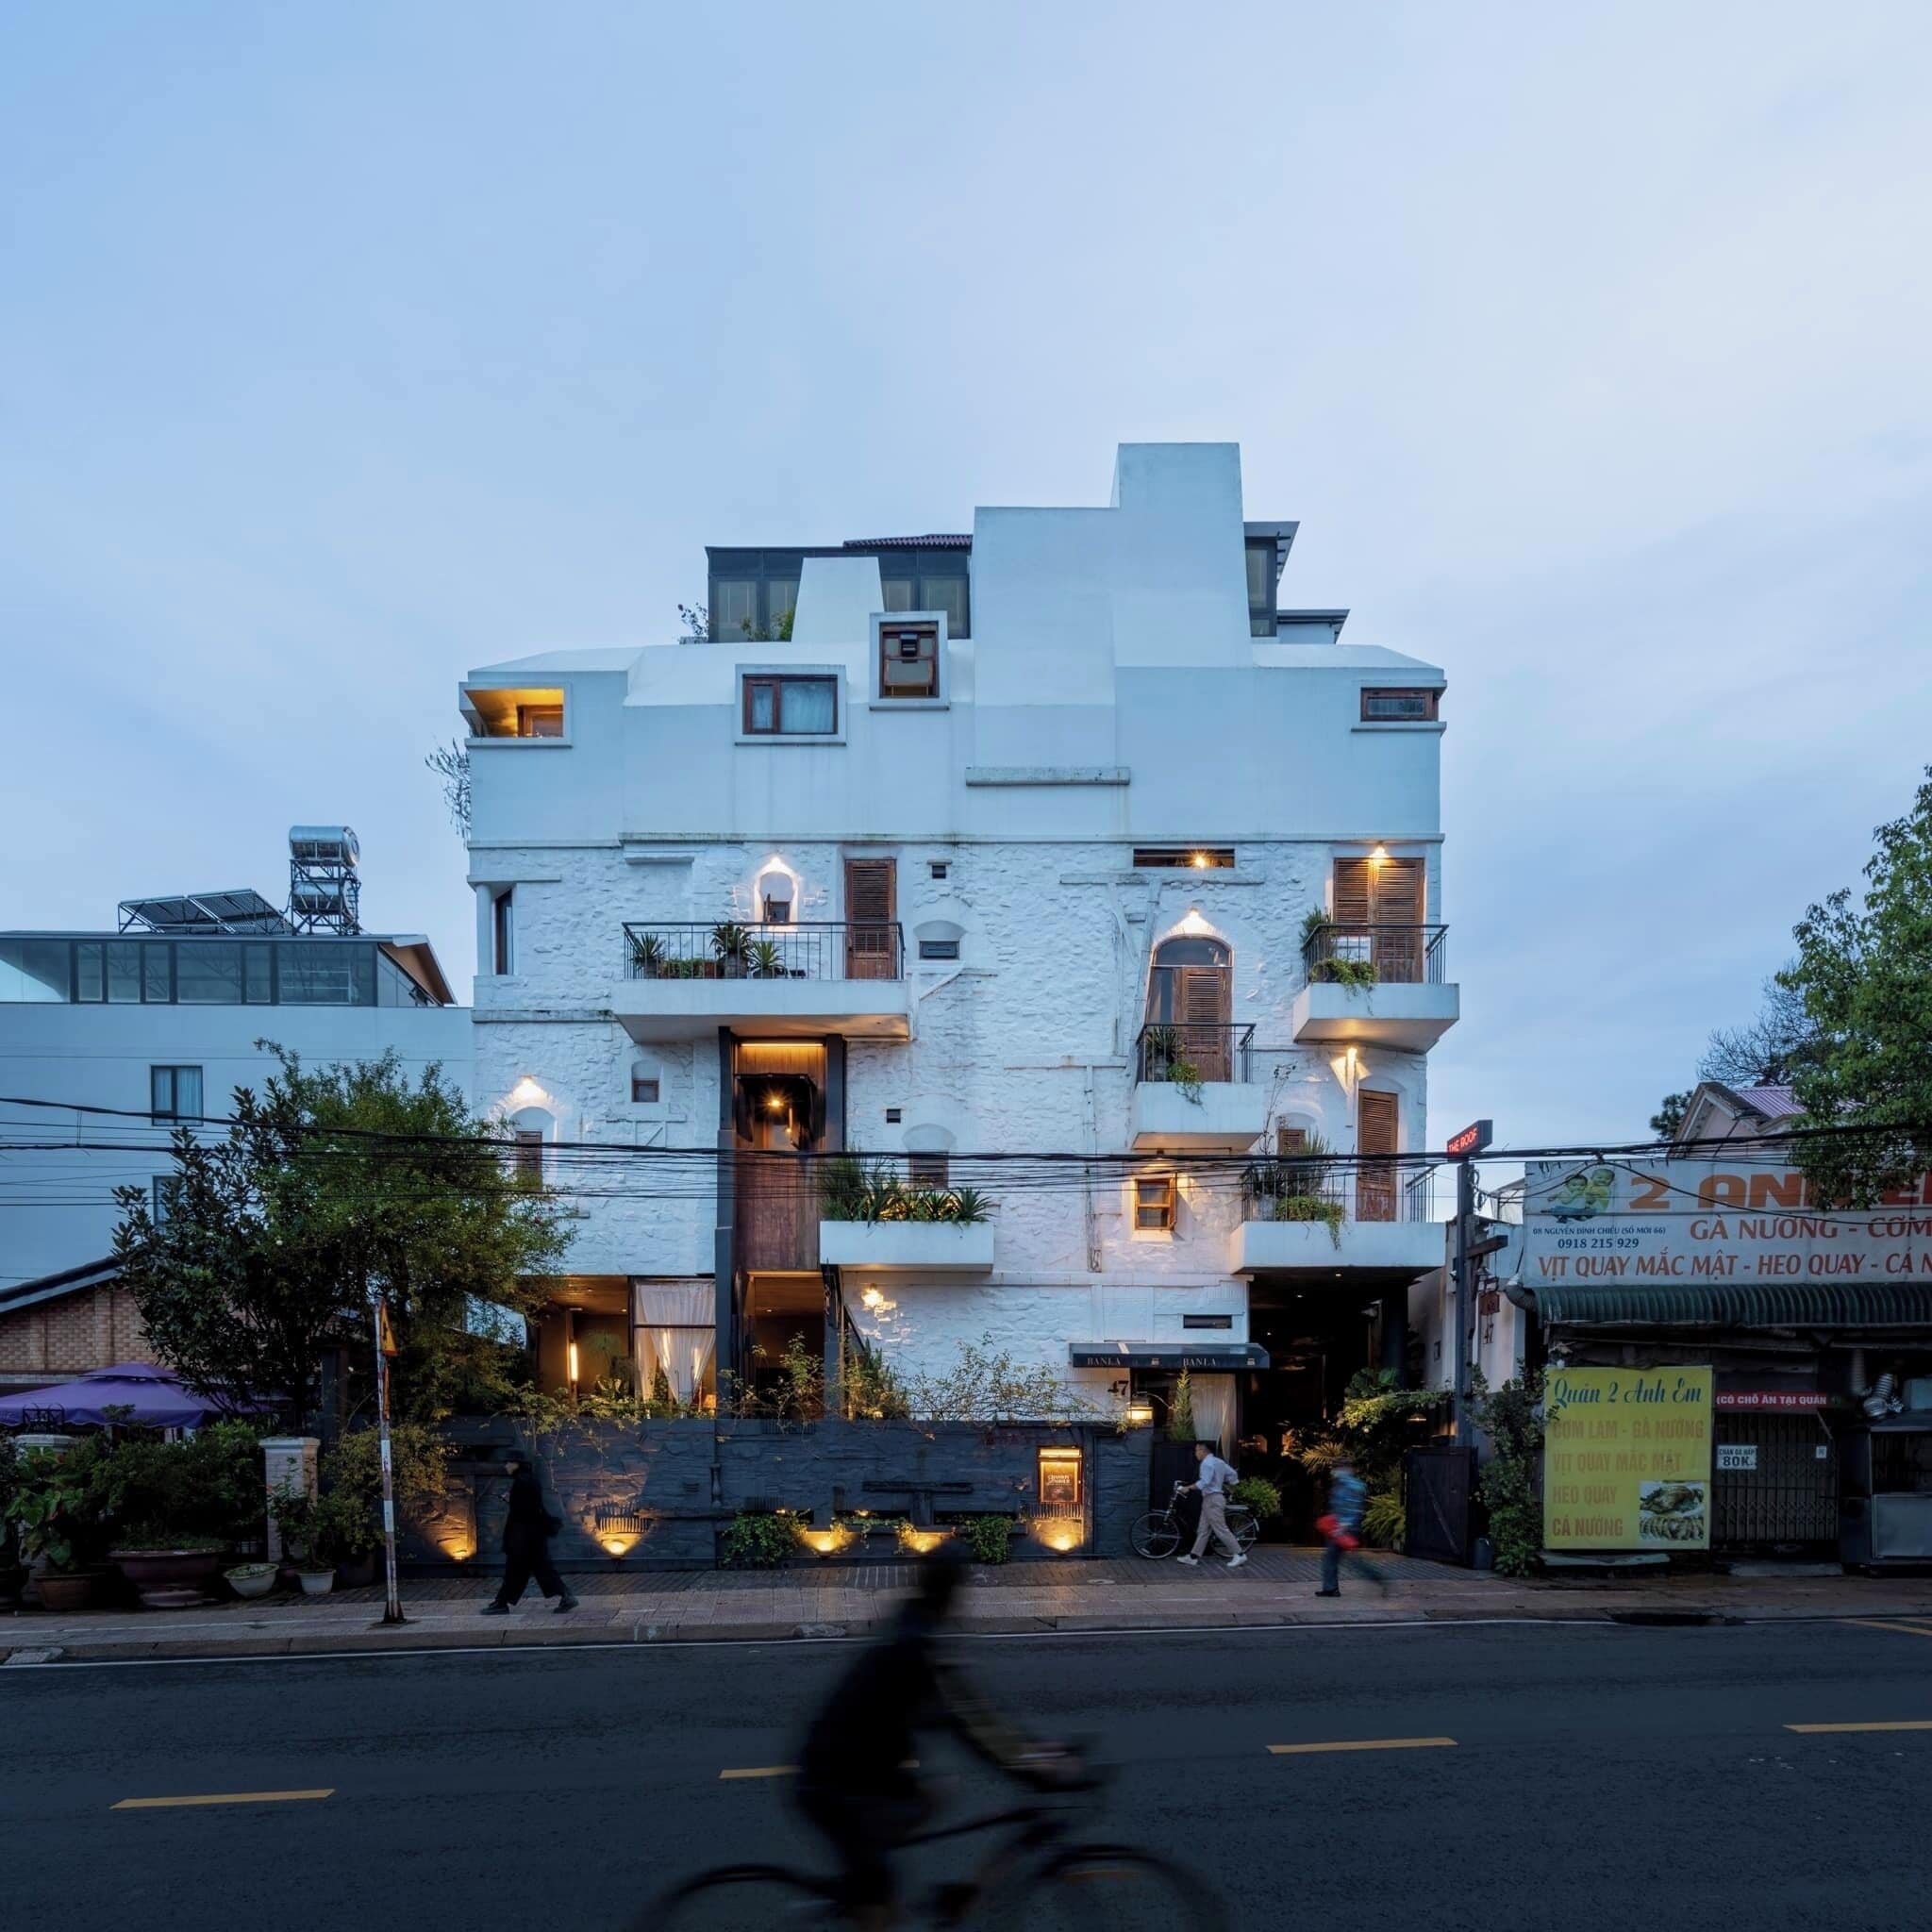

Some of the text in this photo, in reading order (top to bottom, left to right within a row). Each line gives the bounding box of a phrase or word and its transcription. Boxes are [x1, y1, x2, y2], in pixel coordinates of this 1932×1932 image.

[1460, 1127, 1477, 1147] ROOF
[1629, 1176, 1670, 1208] 2
[1690, 1214, 1728, 1241] GÀ
[1557, 1238, 1640, 1249] 0918 215 929
[1539, 1257, 1570, 1281] VỊT
[1575, 1256, 1631, 1278] QUAY
[1636, 1246, 1685, 1277] MẮC
[1691, 1249, 1739, 1280] MẬT
[1757, 1255, 1802, 1275] HEO
[1807, 1254, 1867, 1276] QUAY
[1885, 1246, 1914, 1274] CÁ
[1108, 1380, 1129, 1396] 47
[1607, 1382, 1619, 1404] 2
[1624, 1378, 1666, 1404] Anh
[1672, 1377, 1702, 1404] Em
[1577, 1453, 1612, 1474] QUAY
[1553, 1486, 1618, 1507] HEO QUAY
[1553, 1513, 1572, 1537] CÁ
